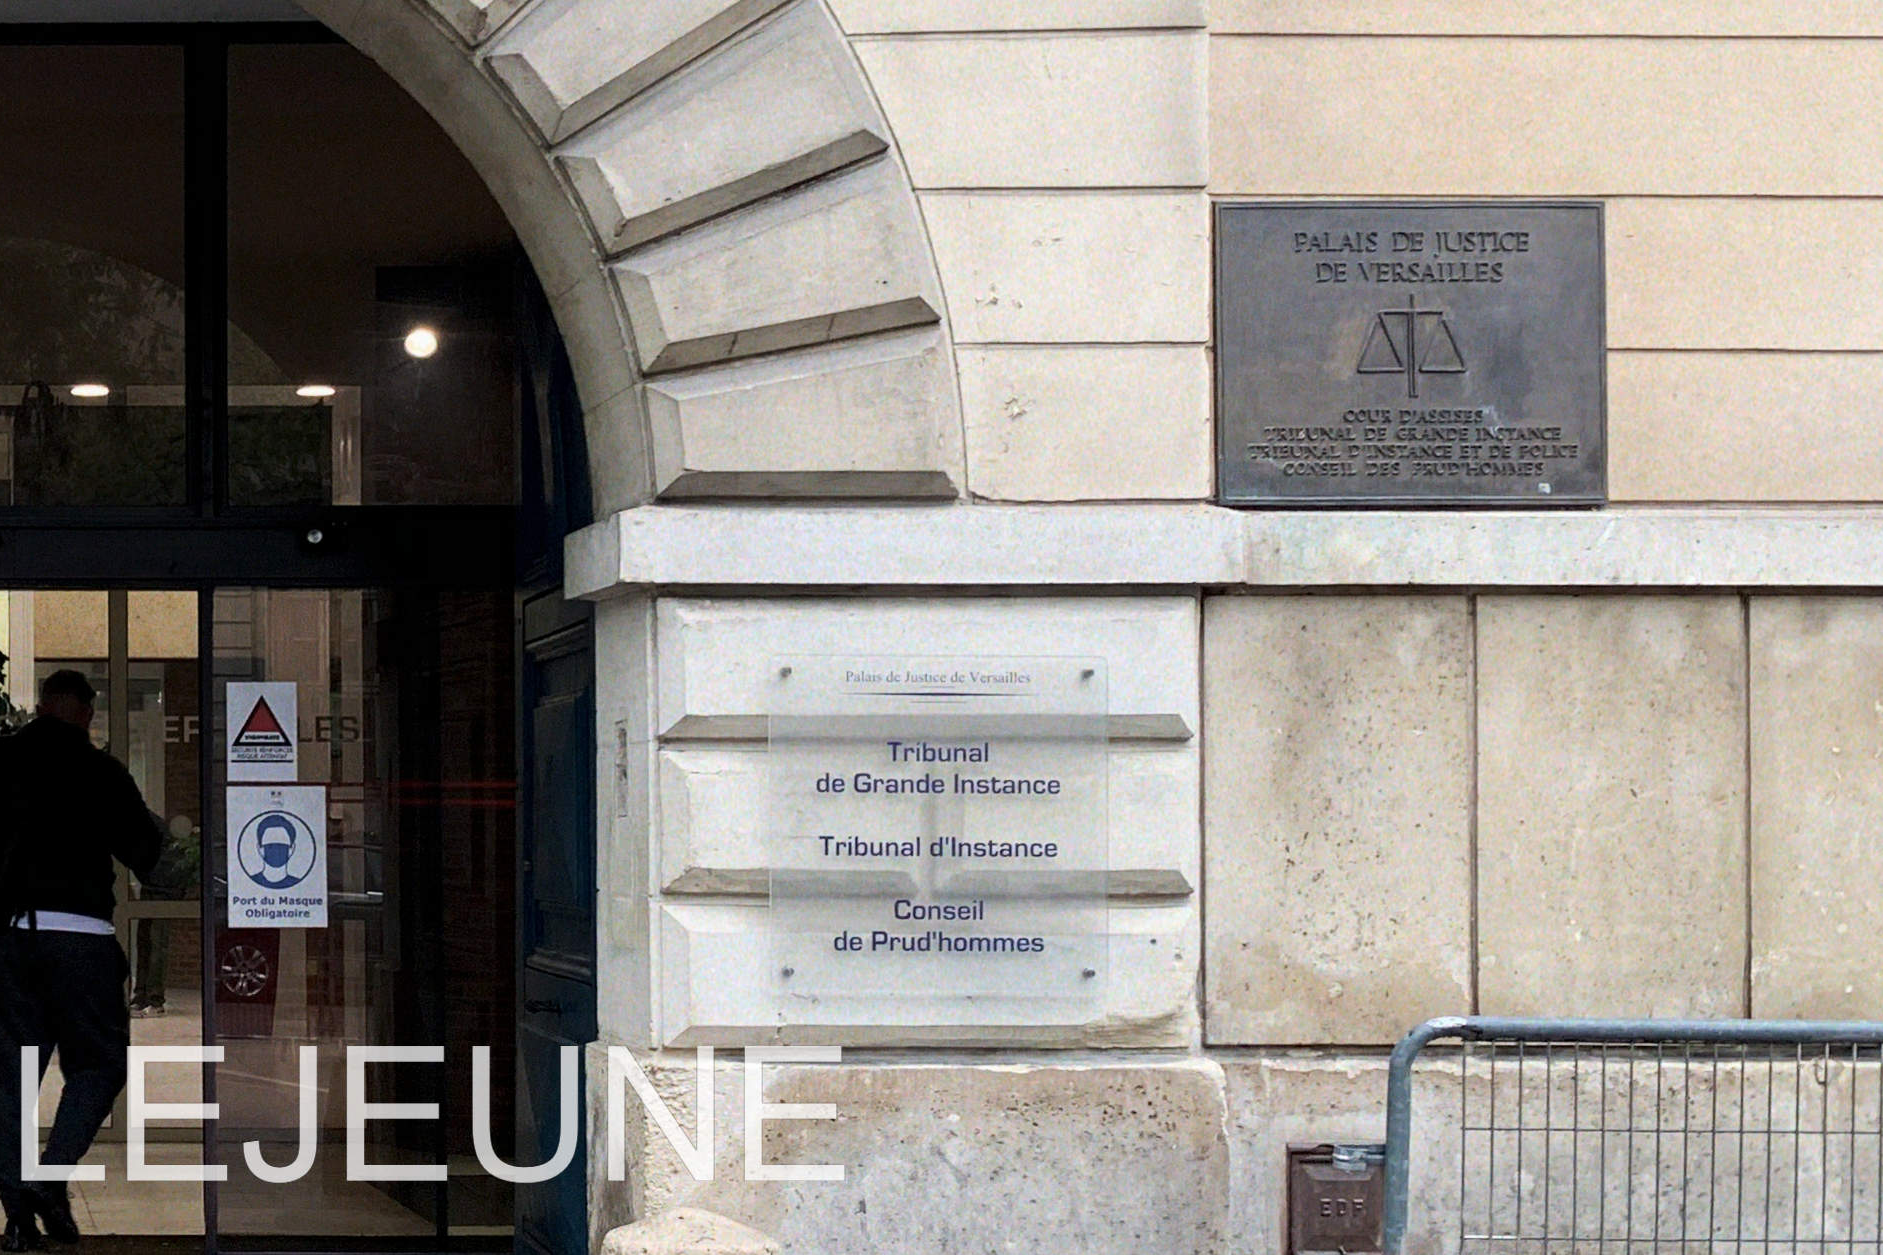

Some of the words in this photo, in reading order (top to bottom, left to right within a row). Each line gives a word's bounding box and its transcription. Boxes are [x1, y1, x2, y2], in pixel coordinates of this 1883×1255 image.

[1294, 231, 1379, 254] PALAIS
[1392, 231, 1424, 252] DE
[1433, 231, 1530, 258] JUSTICE
[1316, 262, 1347, 283] DE
[1358, 262, 1504, 284] VERSAILLES
[1343, 409, 1392, 423] COUR
[1399, 409, 1483, 424] D'ASSISES
[1264, 426, 1356, 441] TRIBUNAL
[1364, 426, 1388, 441] DE
[1396, 426, 1468, 441] GRANDE
[1475, 426, 1561, 441] INSTANCE
[1247, 444, 1341, 459] TRIBUNAL
[1348, 444, 1452, 459] D'INSTANCE
[1459, 444, 1483, 459] ET
[1489, 444, 1512, 459] DE
[1518, 444, 1579, 459] POLICE
[1283, 461, 1357, 476] CONSEIL
[1366, 461, 1400, 476] DES
[1412, 461, 1545, 477] PRUD'HOMMES
[845, 670, 882, 684] Palais
[886, 670, 901, 684] de
[904, 671, 947, 684] Justice
[950, 671, 965, 684] de
[969, 671, 1032, 685] Versailles
[887, 742, 990, 763] Tribunal
[816, 773, 845, 795] de
[854, 773, 945, 795] Grande
[954, 773, 1061, 795] Instance
[819, 836, 921, 857] Tribunal
[929, 836, 1059, 858] d'Instance
[233, 896, 258, 906] Port
[260, 896, 275, 905] du
[278, 896, 324, 907] Masque
[893, 900, 985, 921] Conseil
[245, 908, 311, 919] Obligatoire
[833, 931, 863, 952] de
[871, 931, 1045, 953] Prud'hommes
